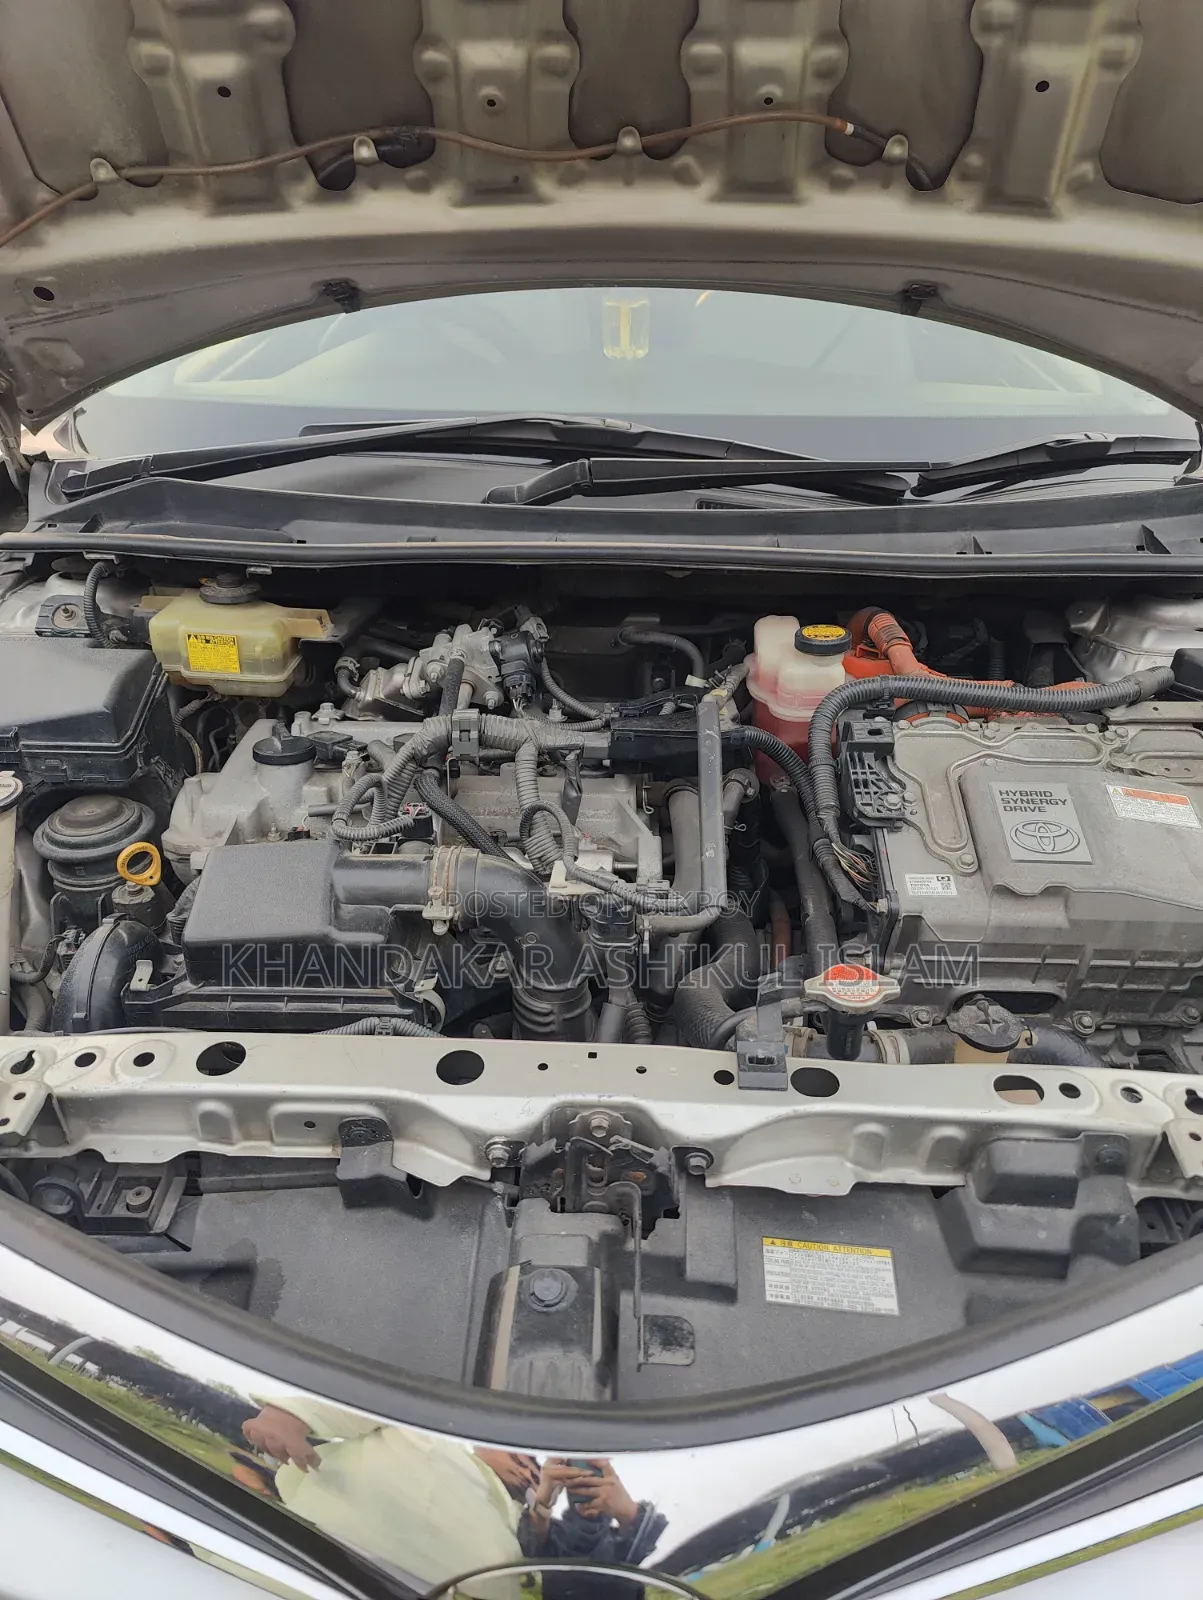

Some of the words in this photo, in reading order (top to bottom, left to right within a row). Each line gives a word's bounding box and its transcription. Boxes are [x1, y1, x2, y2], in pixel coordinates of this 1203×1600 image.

[998, 789, 1053, 798] HYBRID
[1000, 797, 1067, 806] SYNERGY
[1002, 805, 1047, 813] DRIVE
[797, 1241, 829, 1251] CAUTION
[832, 1244, 873, 1255] ATTENTION
